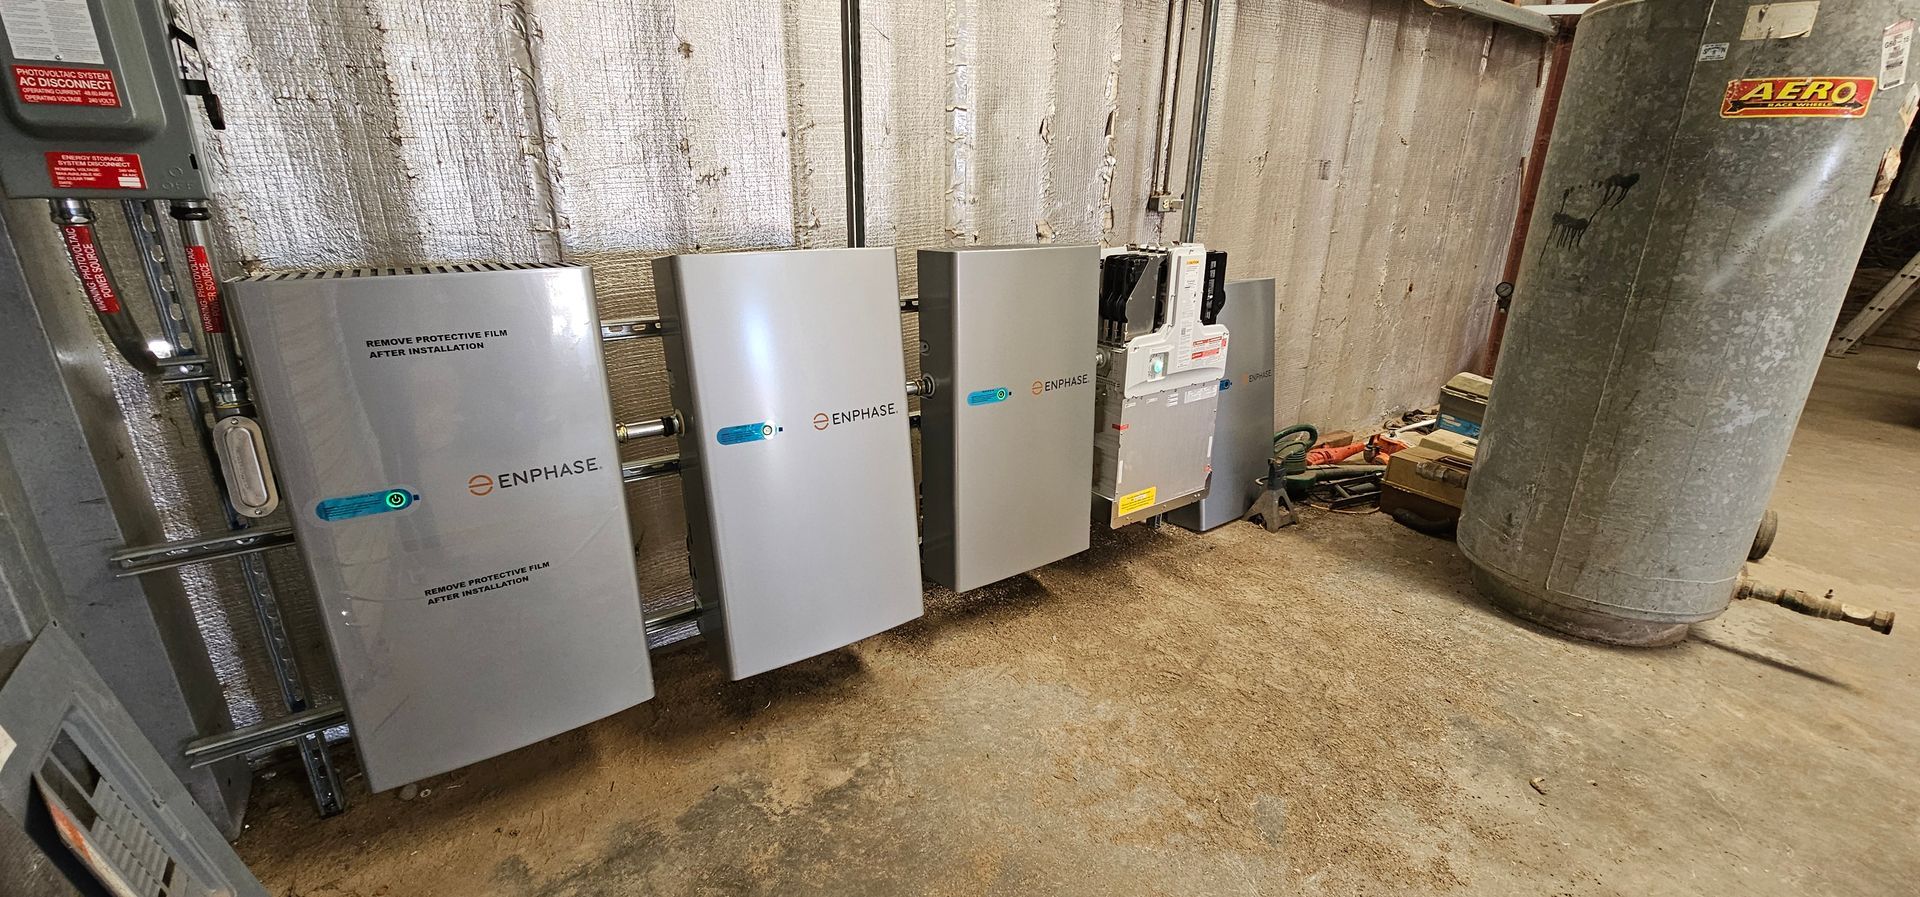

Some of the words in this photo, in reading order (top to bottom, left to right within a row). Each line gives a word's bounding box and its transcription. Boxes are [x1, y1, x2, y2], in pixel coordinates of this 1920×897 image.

[16, 68, 77, 79] PHOTOVOLTAIC
[77, 71, 109, 80] SYSTEM
[19, 76, 37, 87] AC
[38, 77, 112, 90] DISCONNECT
[24, 94, 57, 102] OPERATING
[57, 95, 82, 103] VOLTAGE
[1739, 81, 1858, 104] AERO
[65, 228, 92, 280] PHOTOVOLTAIC
[82, 243, 103, 274] SOURCE
[186, 247, 206, 299] PHOTOVOLTAIC
[198, 262, 216, 291] SOURCE
[94, 273, 114, 298] POWER
[207, 291, 221, 317] POWER
[366, 337, 413, 348] REMOVE
[415, 331, 482, 344] PROTECTIVE
[484, 329, 508, 338] FILM
[369, 348, 406, 359] AFTER
[408, 342, 484, 355] INSTALLATION
[1045, 374, 1089, 392] ENPHASE
[1248, 369, 1272, 383] ENPHASE
[832, 403, 896, 425] ENPHASE
[498, 457, 599, 489] ENPHASE
[424, 581, 466, 597] REMOVE
[468, 566, 527, 587] PROTECTIVE
[529, 561, 550, 572] FILM
[427, 592, 460, 606] AFTER
[461, 575, 529, 598] INSTALLATION
